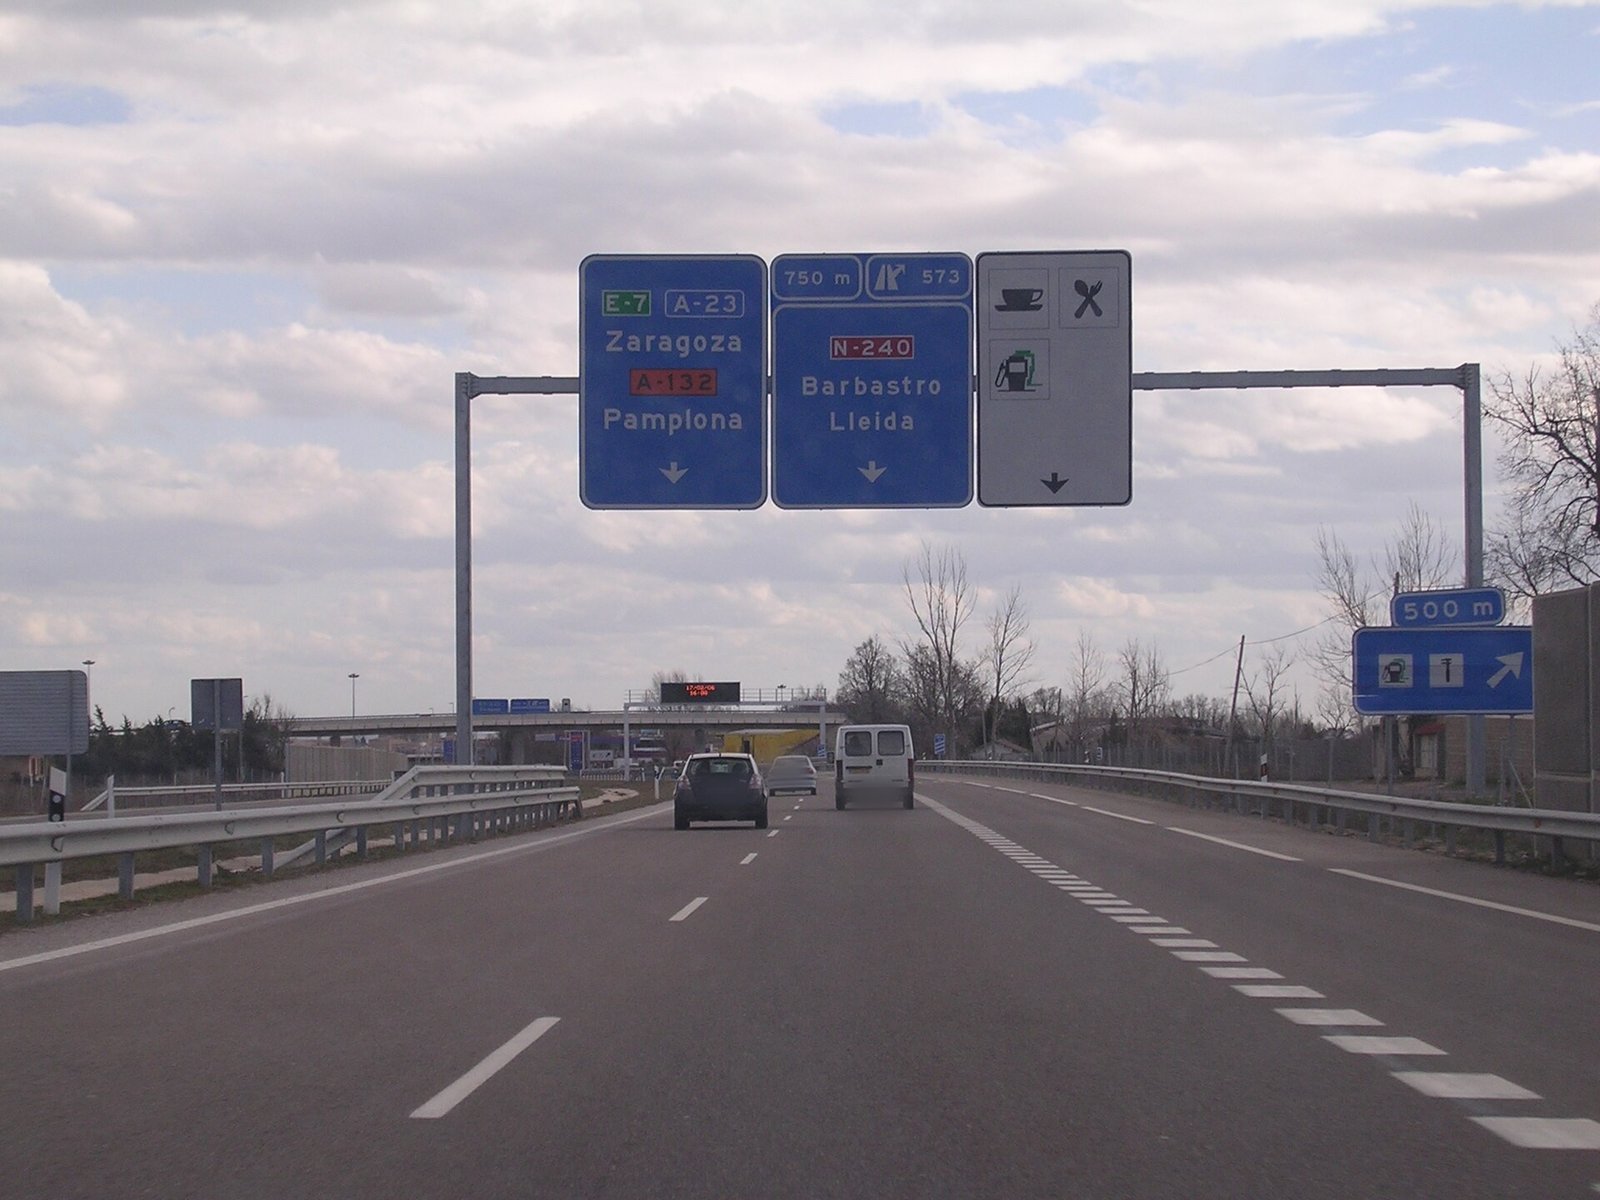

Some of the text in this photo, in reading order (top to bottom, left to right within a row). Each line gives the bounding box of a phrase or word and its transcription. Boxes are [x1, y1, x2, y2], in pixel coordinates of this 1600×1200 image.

[784, 271, 850, 286] 750 m
[922, 269, 960, 285] 573
[605, 292, 648, 312] E-7
[673, 294, 738, 313] A-23
[605, 331, 742, 358] Zaragoza
[833, 339, 911, 357] N-240
[636, 372, 712, 391] A-132
[802, 376, 941, 396] Barbastro
[603, 407, 743, 436] Pamplona
[830, 411, 914, 431] Lleida
[1404, 600, 1494, 620] 500 m
